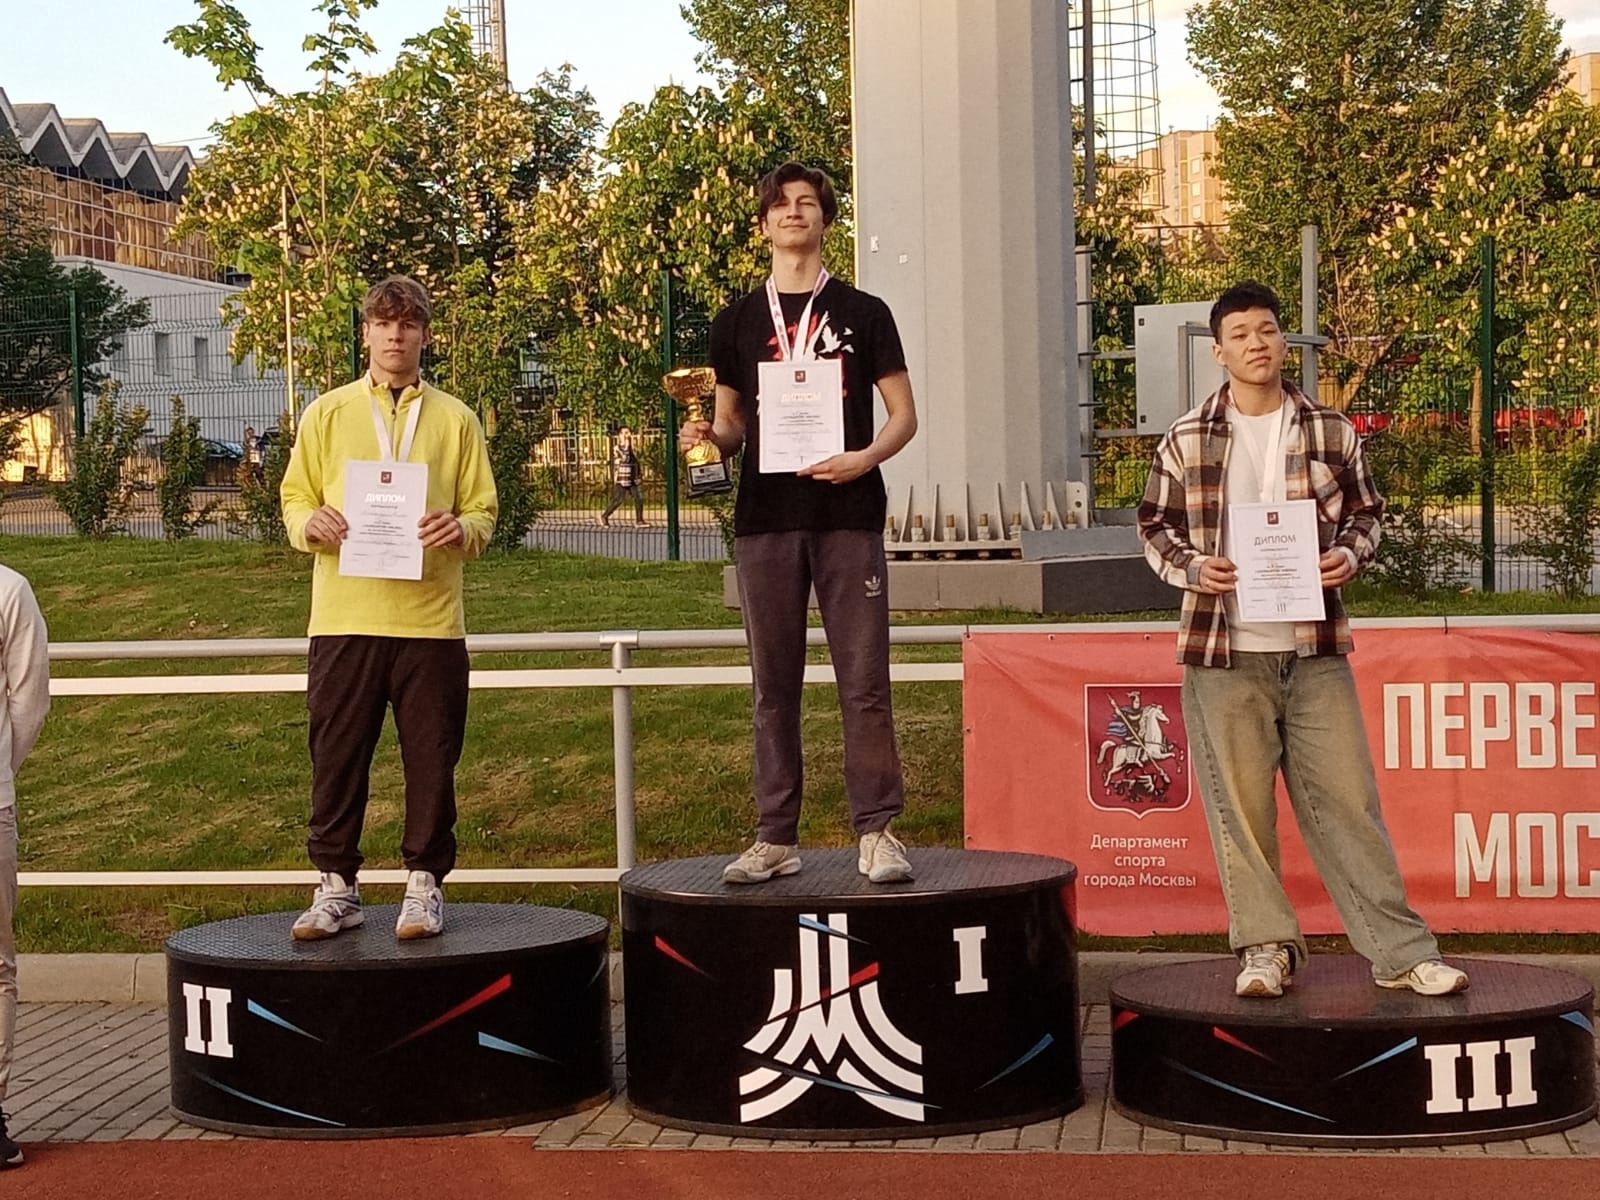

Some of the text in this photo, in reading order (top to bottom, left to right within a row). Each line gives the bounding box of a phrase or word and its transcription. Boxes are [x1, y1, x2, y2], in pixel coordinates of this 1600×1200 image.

[365, 492, 406, 504] ДИПЛОМ
[1254, 534, 1297, 546] ДИПЛОМ
[1383, 682, 1597, 769] ПЕРВЕ
[1090, 834, 1189, 851] Департамент
[1114, 855, 1166, 869] спорта
[1453, 812, 1600, 898] МОС
[1084, 872, 1197, 888] города Москвы
[953, 925, 989, 995] I
[182, 982, 234, 1058] II
[1424, 1036, 1538, 1114] III
